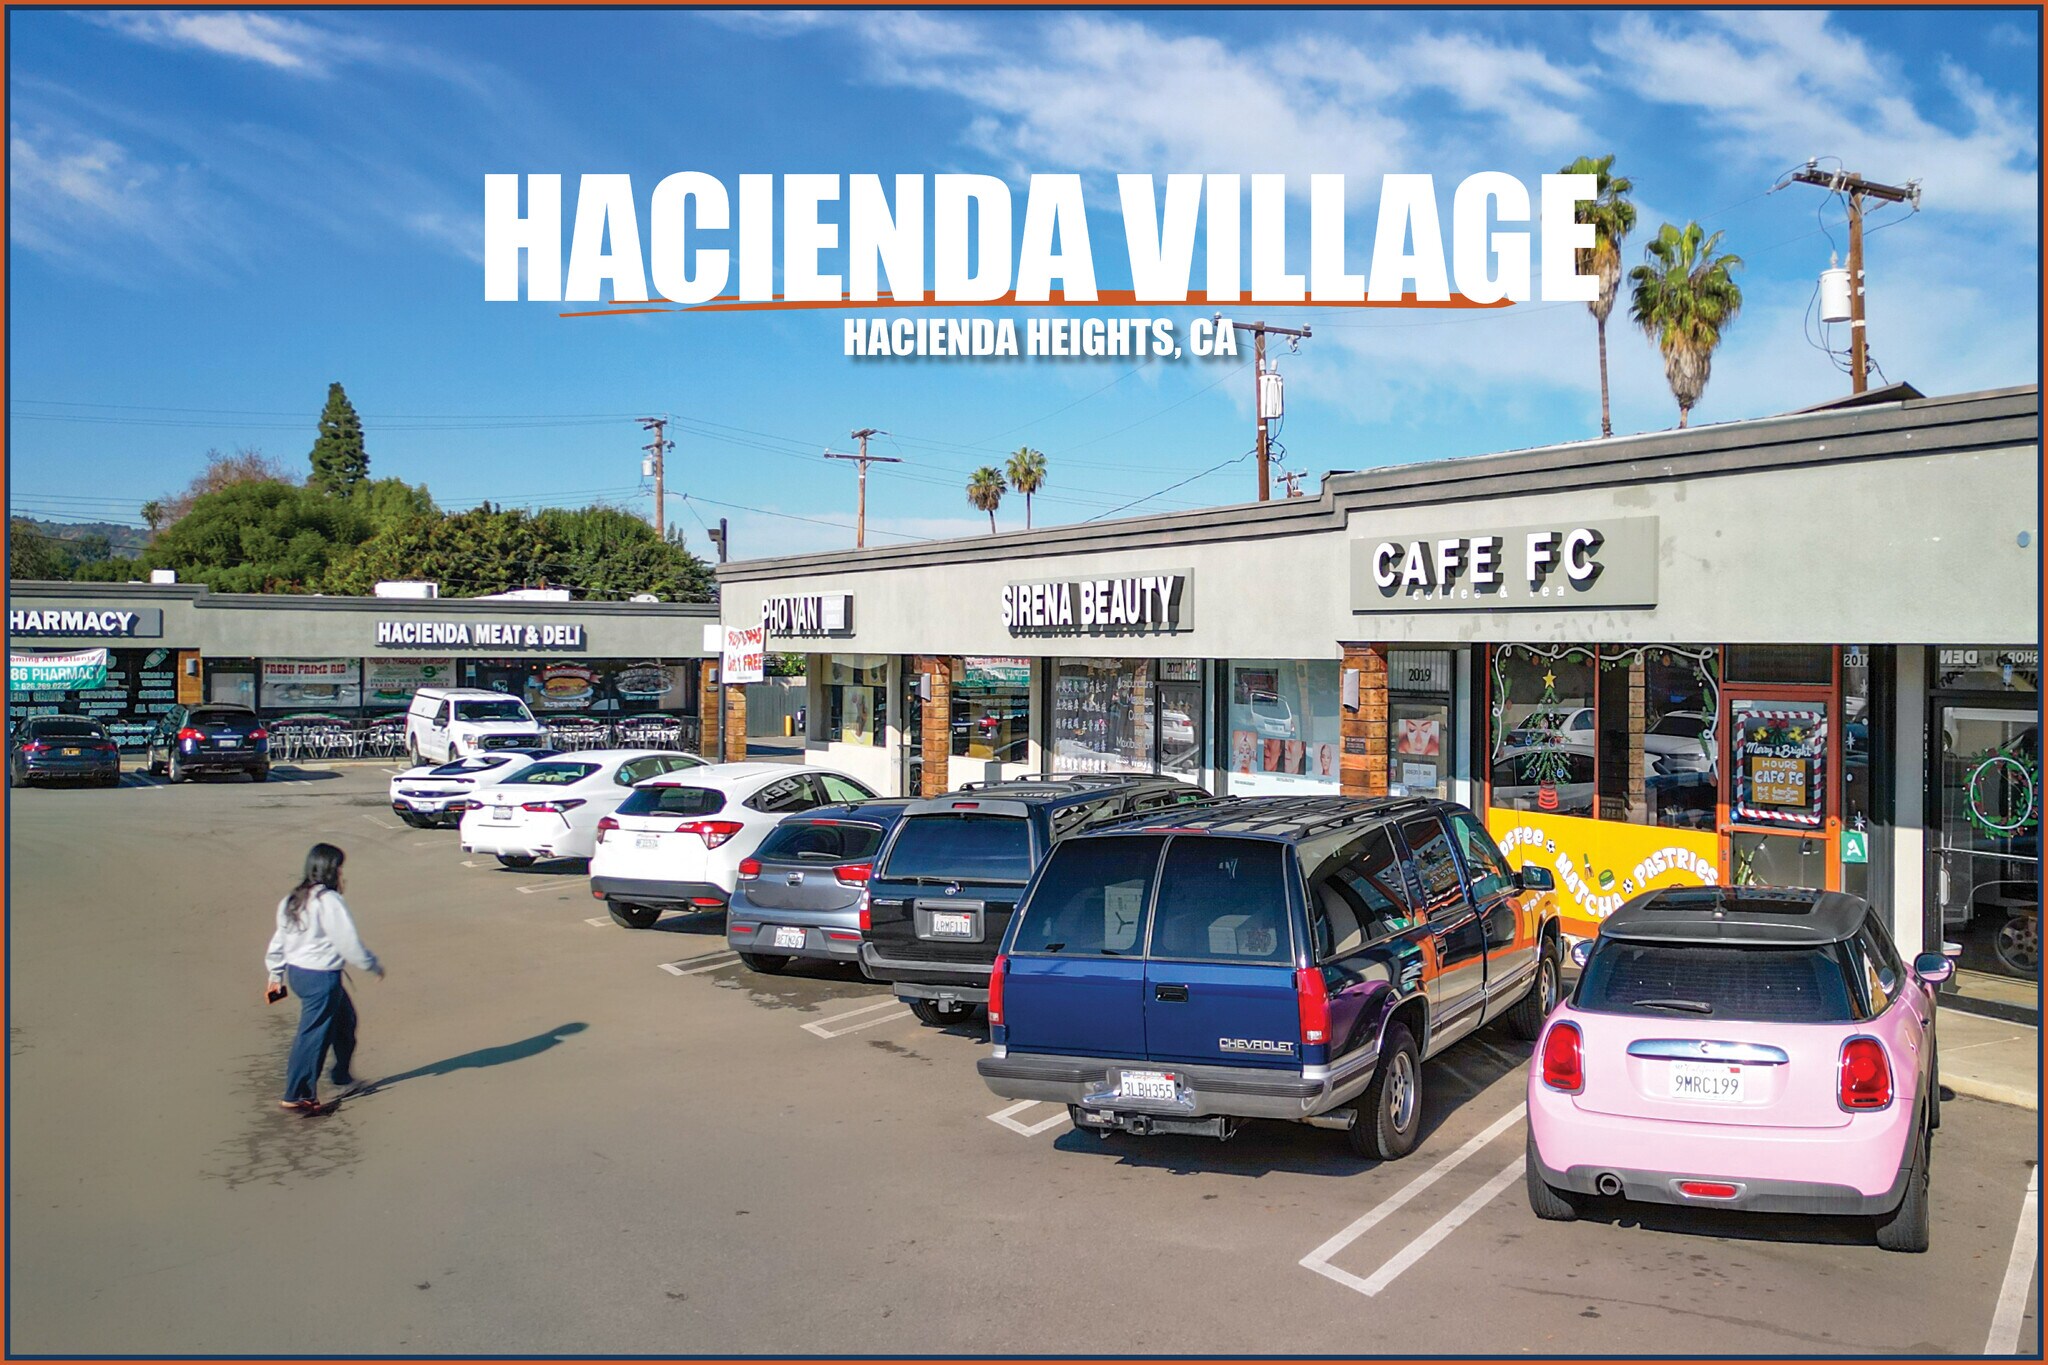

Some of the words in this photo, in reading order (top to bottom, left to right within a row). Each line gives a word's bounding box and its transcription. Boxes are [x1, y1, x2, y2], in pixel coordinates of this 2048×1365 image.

[1372, 537, 1494, 588] CAFE
[1526, 528, 1595, 581] FC
[1001, 583, 1073, 627] SIRENA
[1081, 575, 1175, 624] BEAUTY
[1412, 585, 1481, 600] coffee
[1500, 585, 1508, 598] &
[10, 611, 133, 631] HARMACY
[762, 598, 788, 630] PHO
[790, 596, 818, 630] VAN
[378, 622, 470, 643] HACIENDA
[475, 623, 523, 645] MEAT
[525, 624, 539, 645] &
[543, 625, 581, 645] DELI
[265, 664, 295, 674] FRESH
[298, 664, 328, 674] PRIME
[743, 653, 763, 671] FREE
[32, 666, 100, 681] PHARMACY
[1408, 669, 1431, 682] 2019
[1762, 759, 1798, 770] HOURS
[1788, 771, 1804, 786] FC
[1555, 852, 1625, 918] MATCHA
[1219, 1038, 1294, 1051] CHEVROLET
[1124, 1081, 1173, 1098] 3LBH355
[1675, 1075, 1739, 1095] 9MRC199
